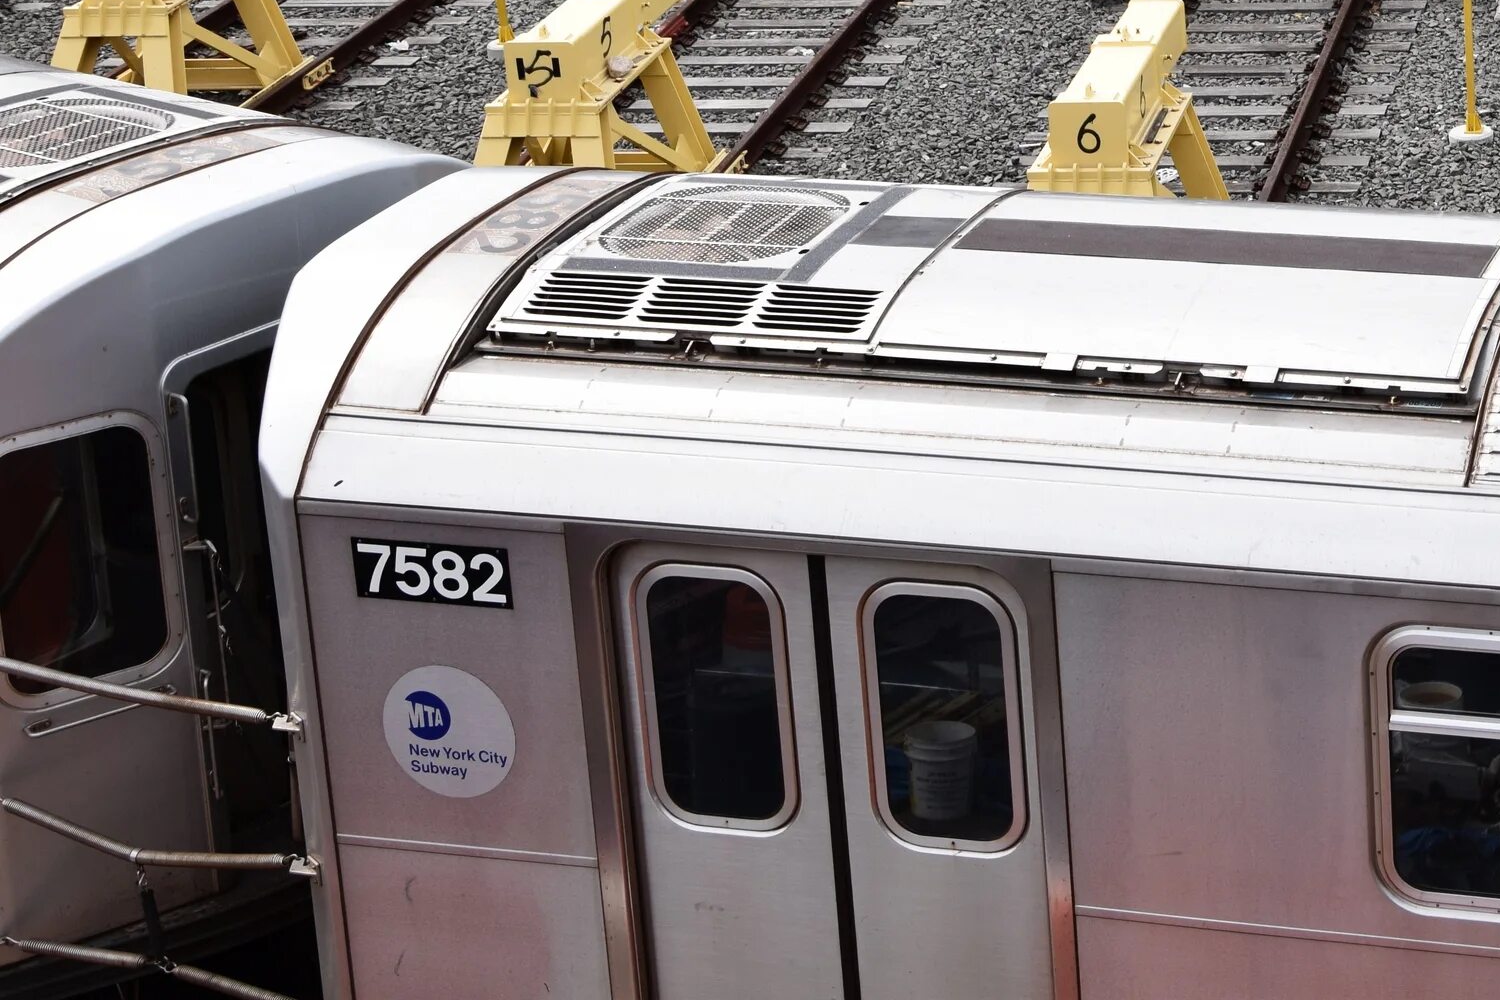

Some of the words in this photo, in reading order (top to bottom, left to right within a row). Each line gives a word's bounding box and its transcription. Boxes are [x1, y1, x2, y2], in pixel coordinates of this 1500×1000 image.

[602, 16, 612, 58] 5
[525, 50, 555, 93] 5
[1077, 113, 1101, 153] 6
[356, 543, 507, 604] 7582
[407, 701, 443, 728] MTA
[409, 744, 440, 759] New
[442, 747, 476, 762] York
[478, 751, 508, 768] City
[411, 760, 467, 779] Subway
